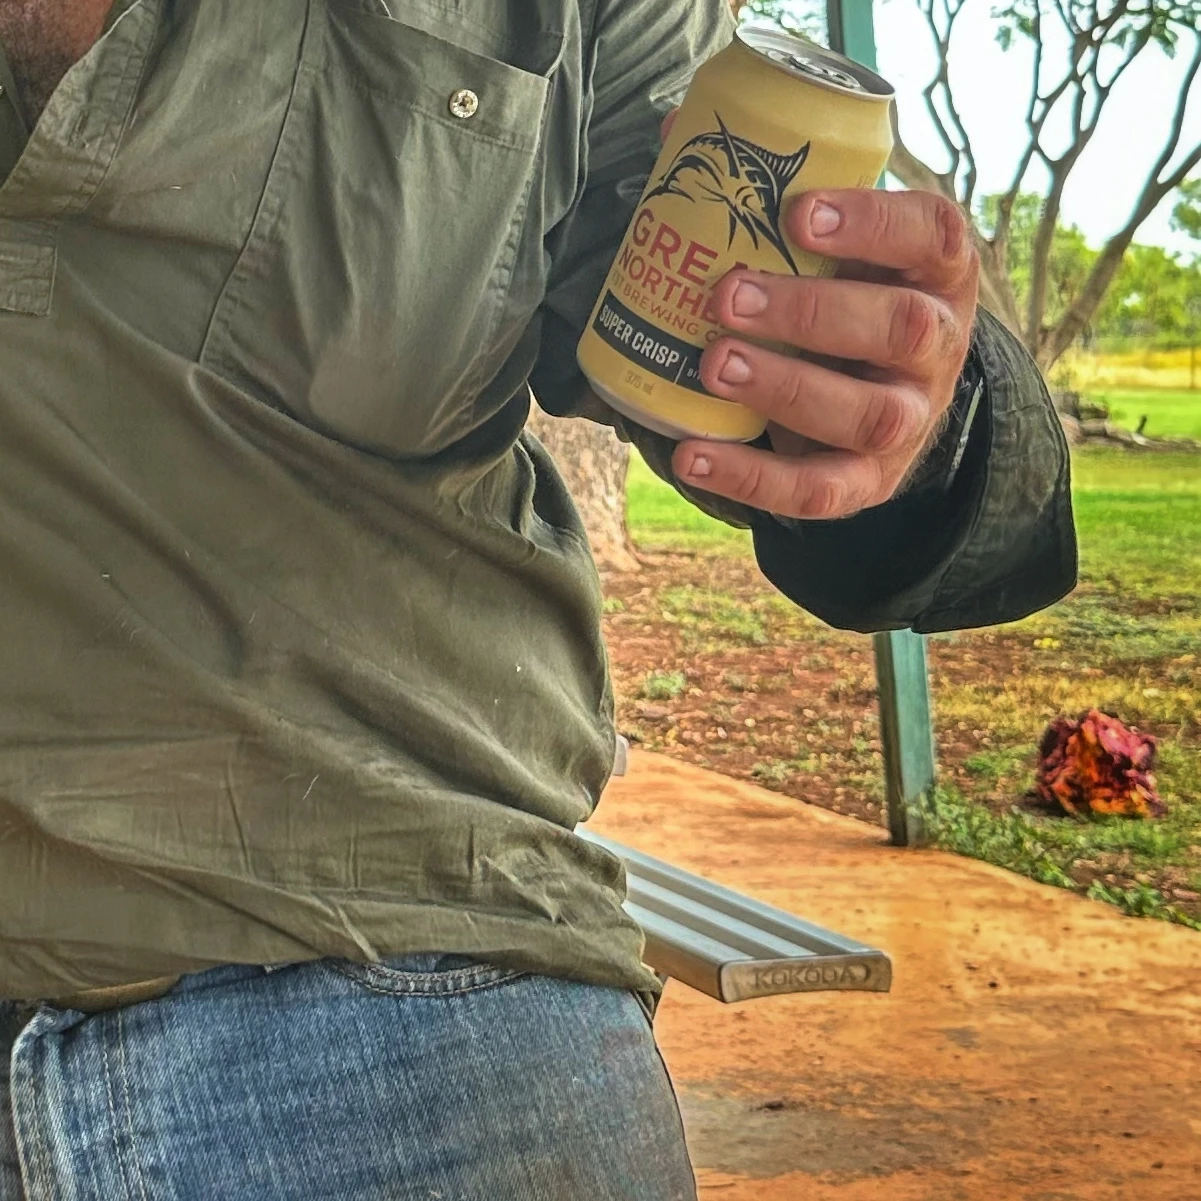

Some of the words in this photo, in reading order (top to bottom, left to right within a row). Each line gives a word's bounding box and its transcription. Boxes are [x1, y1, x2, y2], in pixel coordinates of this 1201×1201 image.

[599, 304, 633, 346] SUPER
[631, 333, 680, 368] CRISP
[623, 286, 699, 336] BREWING
[754, 963, 857, 990] KOKODA
